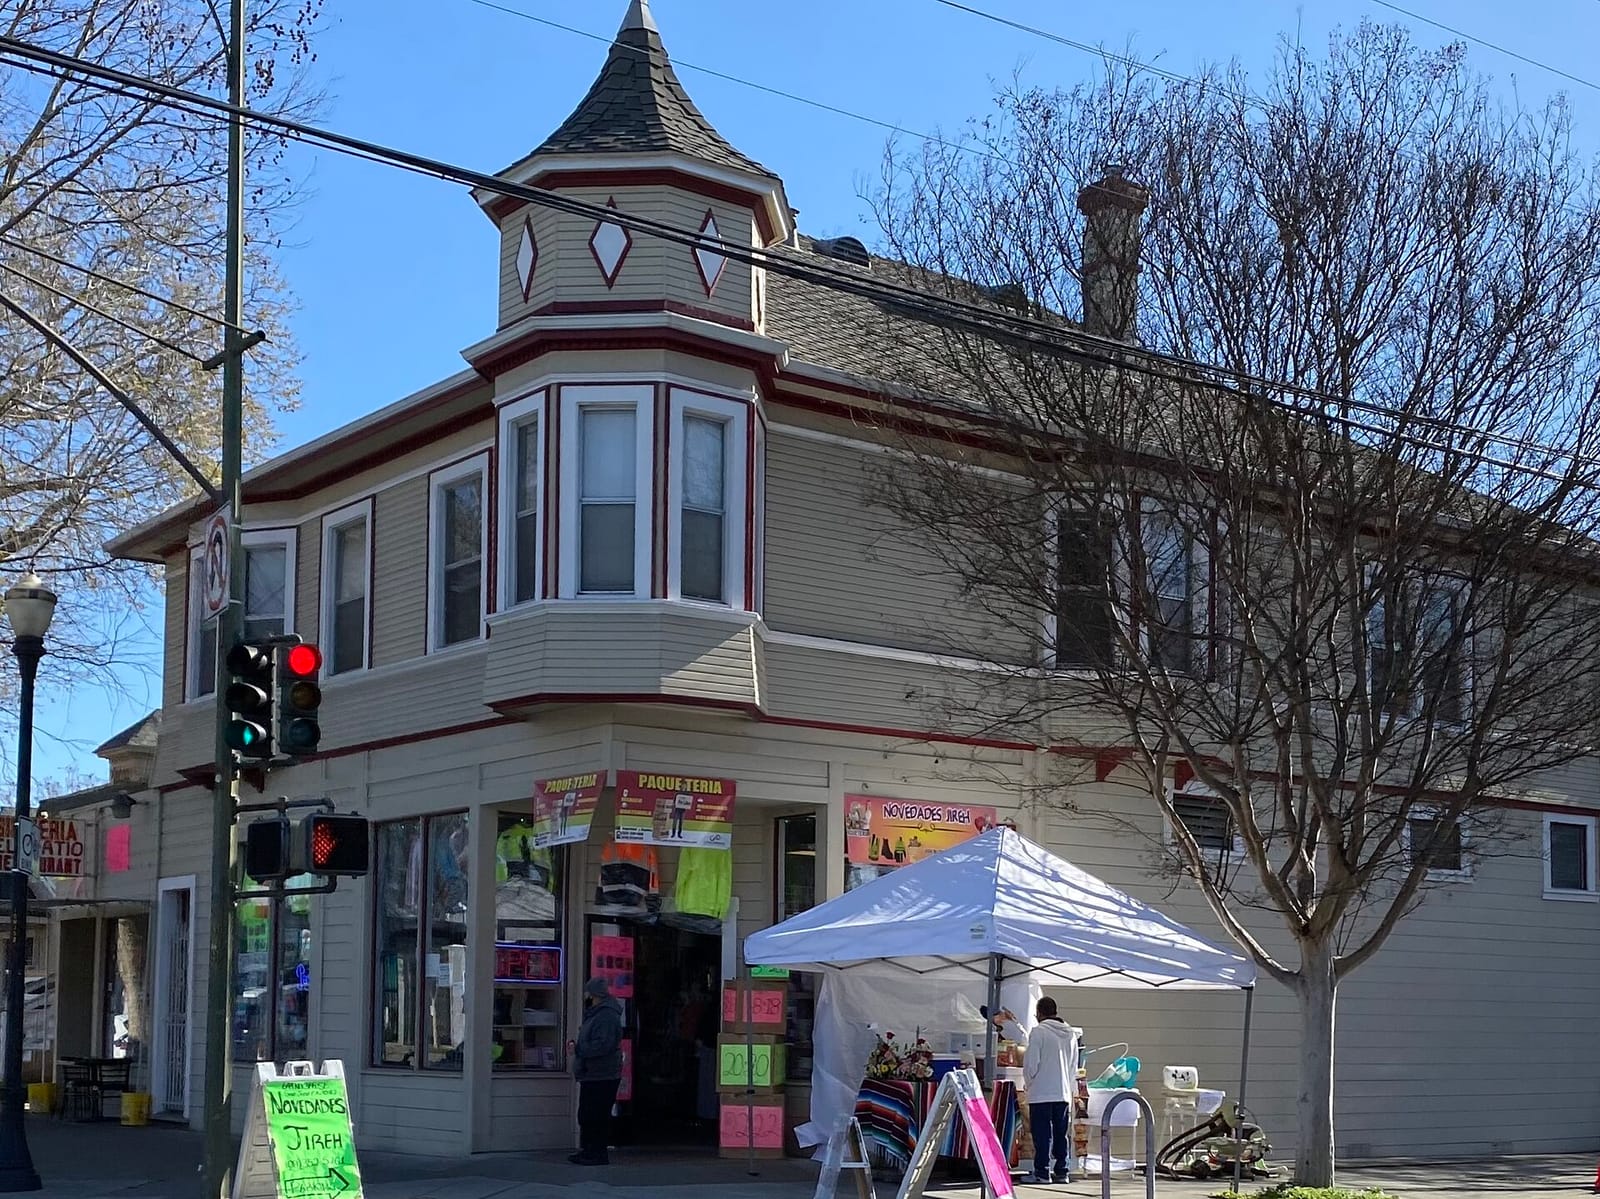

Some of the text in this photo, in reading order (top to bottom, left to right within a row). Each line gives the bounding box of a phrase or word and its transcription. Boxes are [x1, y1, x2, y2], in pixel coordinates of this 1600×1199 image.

[882, 803, 971, 824] NOVEDADES JIREH
[40, 841, 83, 857] ATIO
[269, 1092, 346, 1115] NOVEDADES
[283, 1125, 343, 1150] JIREH
